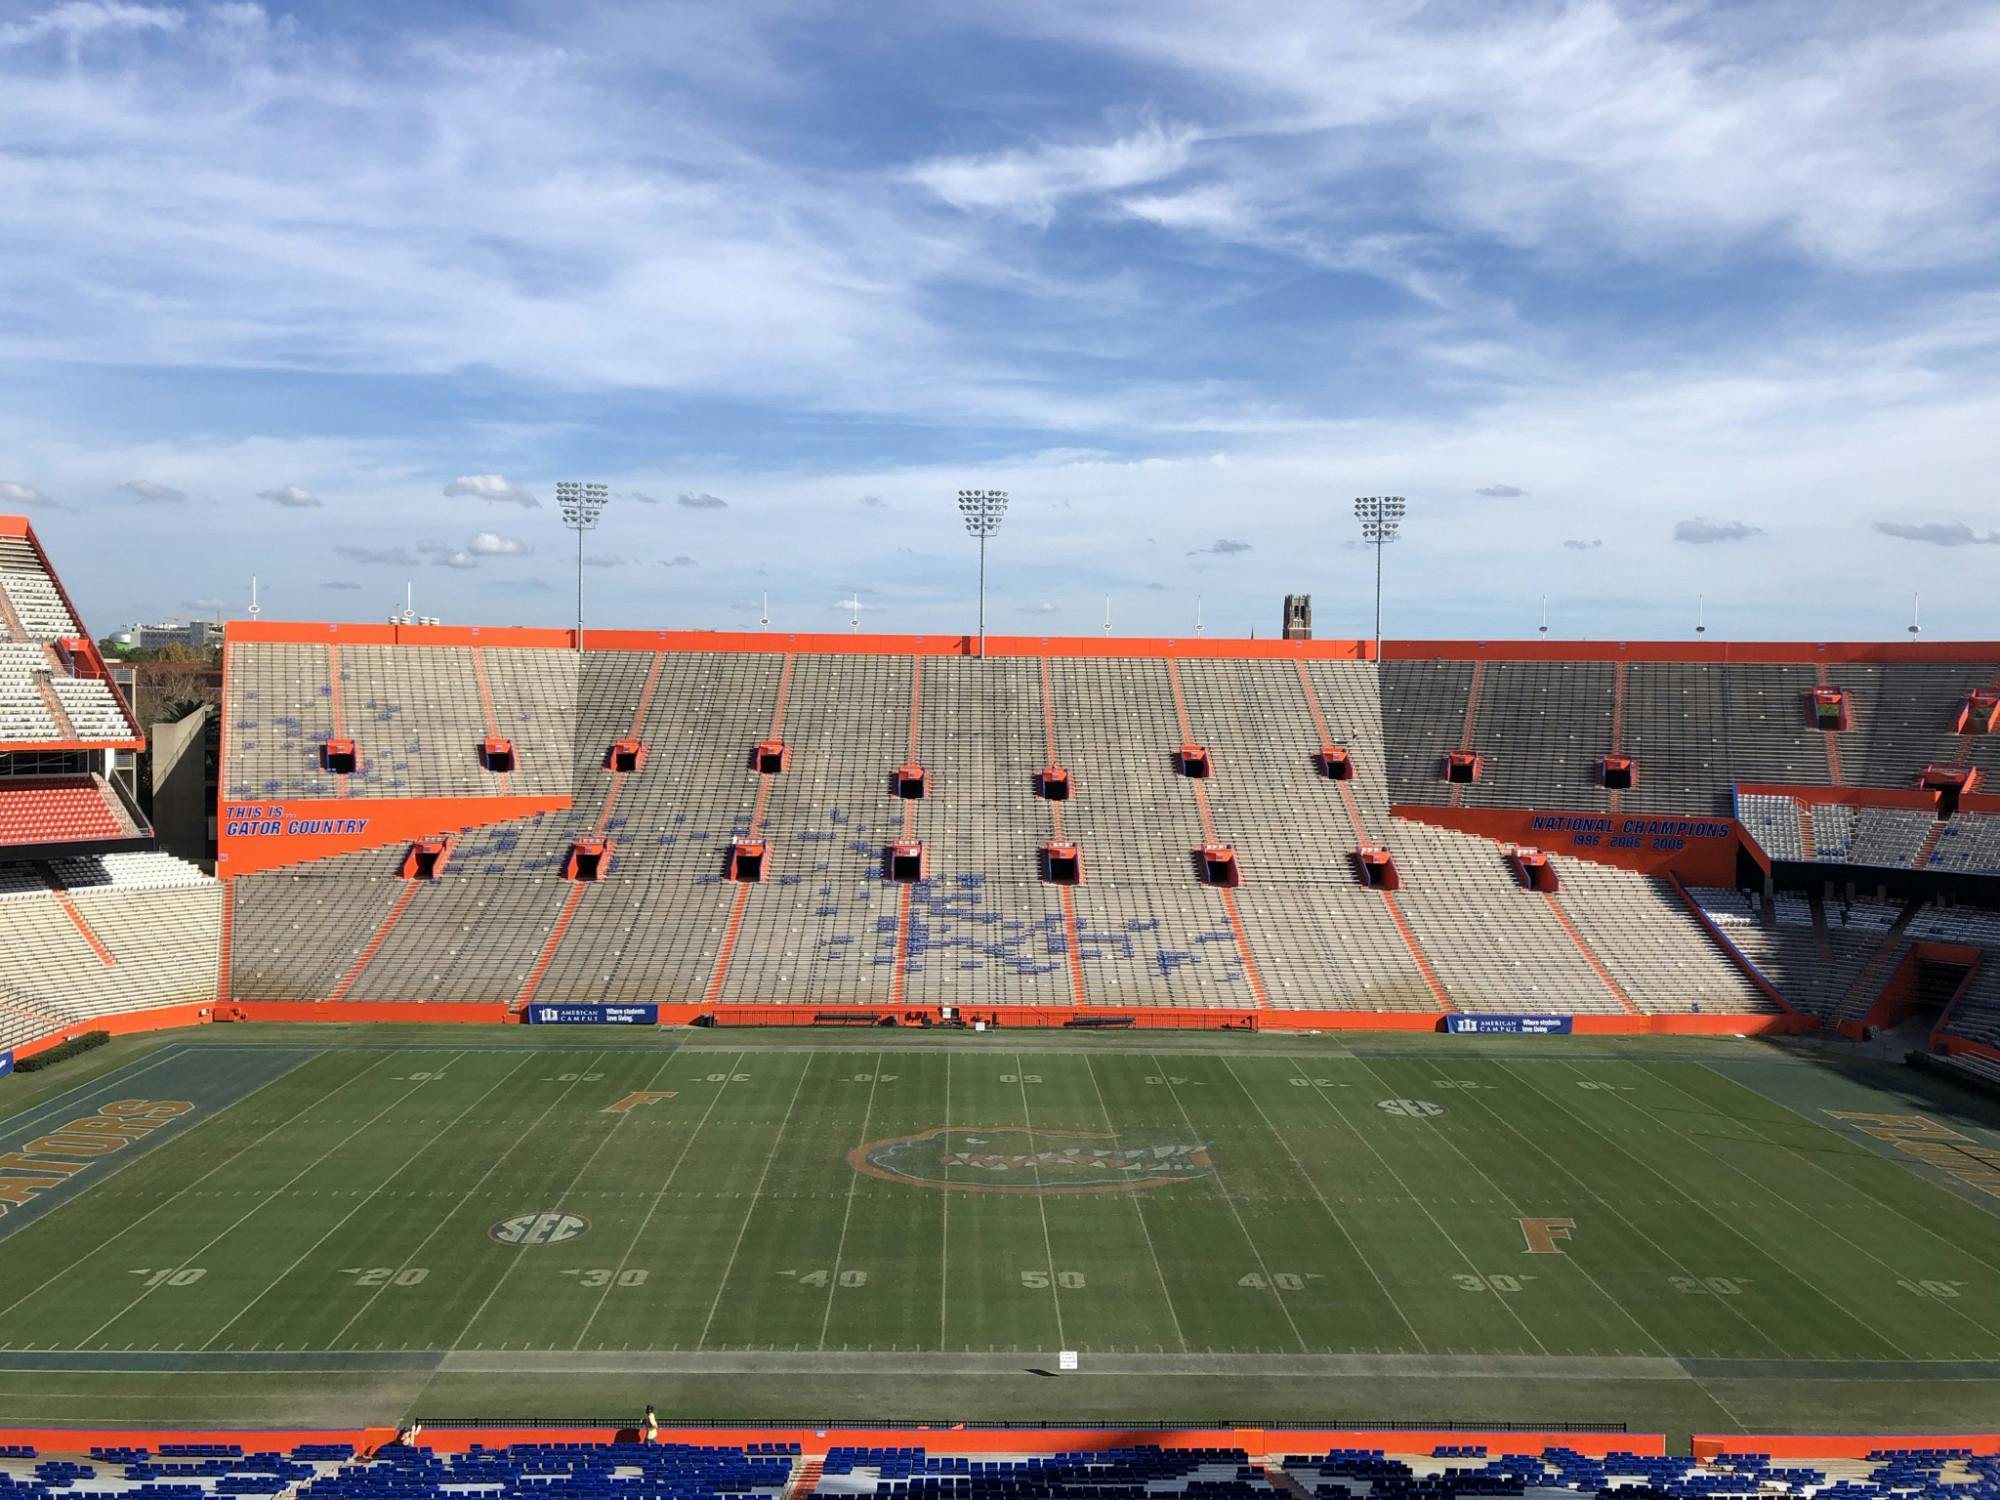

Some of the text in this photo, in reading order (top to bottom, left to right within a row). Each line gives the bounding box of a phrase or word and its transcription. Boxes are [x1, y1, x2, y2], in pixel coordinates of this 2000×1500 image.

[226, 805, 262, 819] THIS
[226, 818, 369, 836] GATOR COUNTRY
[1532, 815, 1730, 838] NATIONAL CHAMPIONS
[1573, 834, 1600, 847] 1996
[1610, 836, 1641, 849] 2006
[557, 1073, 605, 1081] 20
[706, 1074, 751, 1082] 30
[854, 1074, 899, 1082] 40
[1000, 1074, 1044, 1083] 50
[1144, 1076, 1189, 1085] 40
[1289, 1078, 1335, 1087] 30
[599, 1091, 679, 1113] F
[1377, 1099, 1444, 1118] SEC
[0, 1099, 195, 1218] ATORS
[496, 1213, 585, 1244] SEC
[1512, 1217, 1577, 1254] F
[143, 1268, 207, 1286] 10
[352, 1268, 431, 1286] 20
[579, 1269, 650, 1287] 30
[799, 1269, 868, 1287] 40
[1020, 1271, 1086, 1290] 50
[1237, 1272, 1305, 1291] 40
[1451, 1273, 1524, 1292] 30
[1667, 1276, 1742, 1295] 20
[1896, 1279, 1961, 1297] 10
